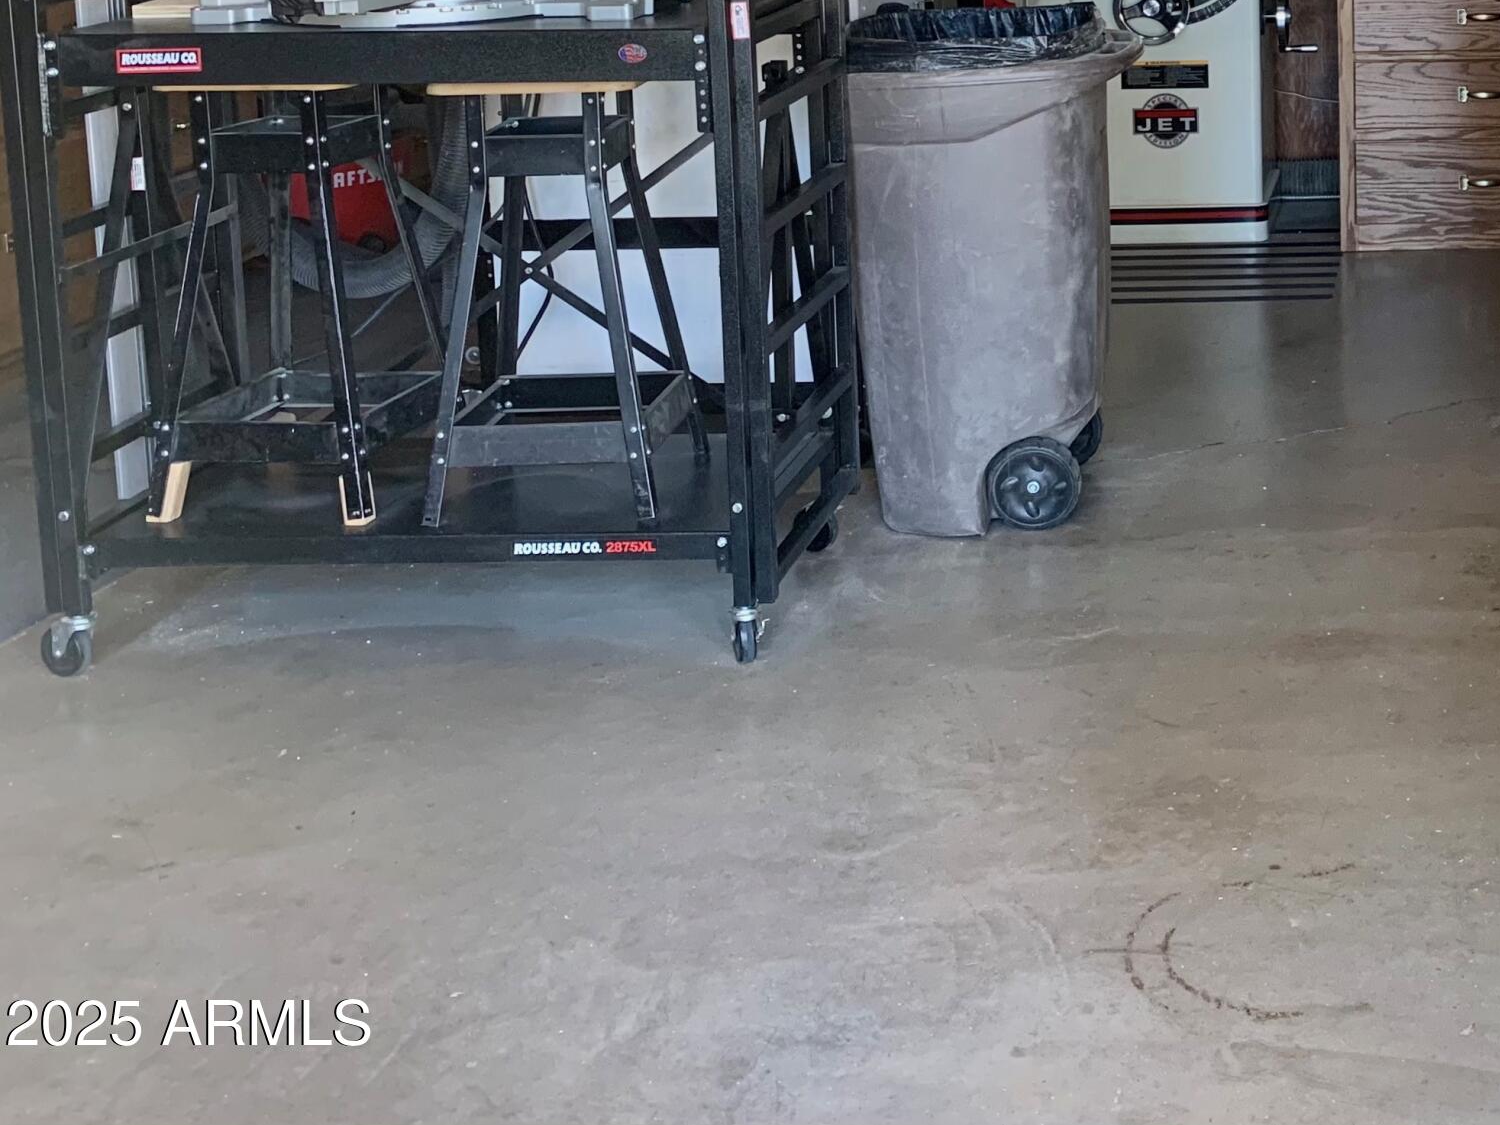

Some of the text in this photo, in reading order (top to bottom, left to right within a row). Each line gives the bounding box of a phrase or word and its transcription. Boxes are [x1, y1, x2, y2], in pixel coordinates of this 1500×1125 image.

[121, 53, 180, 66] ROUSSEAU
[1136, 117, 1196, 132] JET
[513, 541, 656, 555] ROUSSEAU CO. 2875XL
